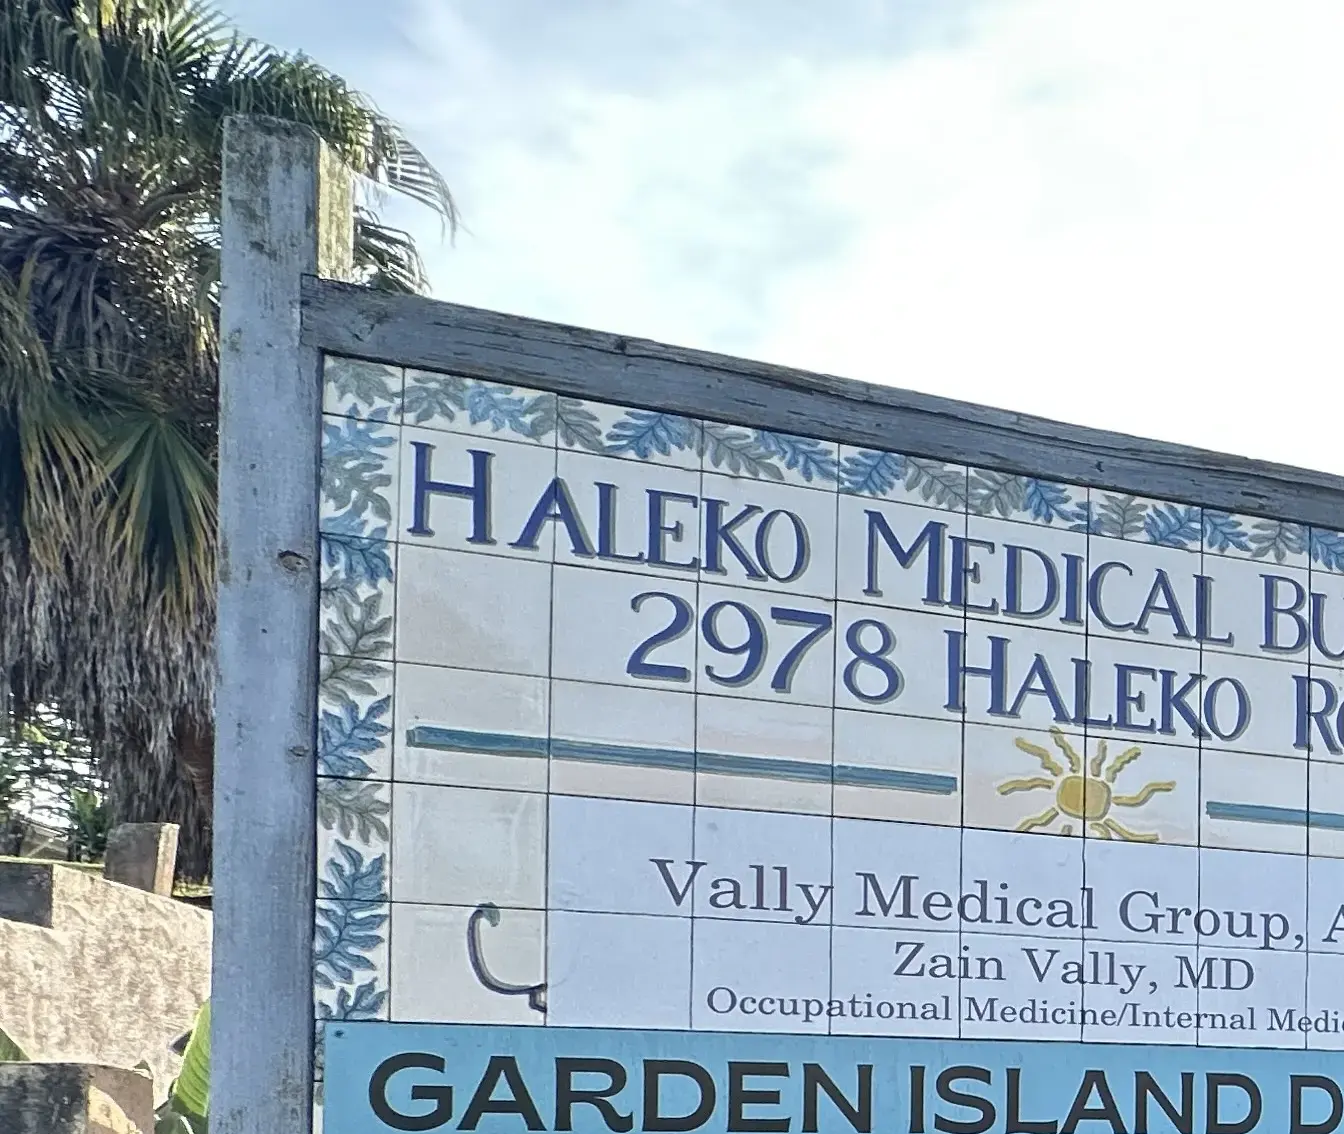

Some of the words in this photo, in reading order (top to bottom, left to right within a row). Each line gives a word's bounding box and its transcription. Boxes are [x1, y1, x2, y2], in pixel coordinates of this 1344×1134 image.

[408, 441, 811, 584] HALEKO
[862, 508, 1235, 649] MEDICAL
[625, 591, 905, 704] 2978
[943, 628, 1251, 742] HALEKO
[649, 858, 834, 925] Vally
[855, 871, 1097, 930] Medical
[1118, 889, 1305, 951] Group,
[706, 986, 952, 1022] Occupational
[965, 995, 1256, 1031] Medicine/Internal
[892, 941, 1006, 981] Zain
[1022, 947, 1159, 995] Vally,
[1174, 955, 1255, 991] MD
[368, 1052, 873, 1134] GARDEN
